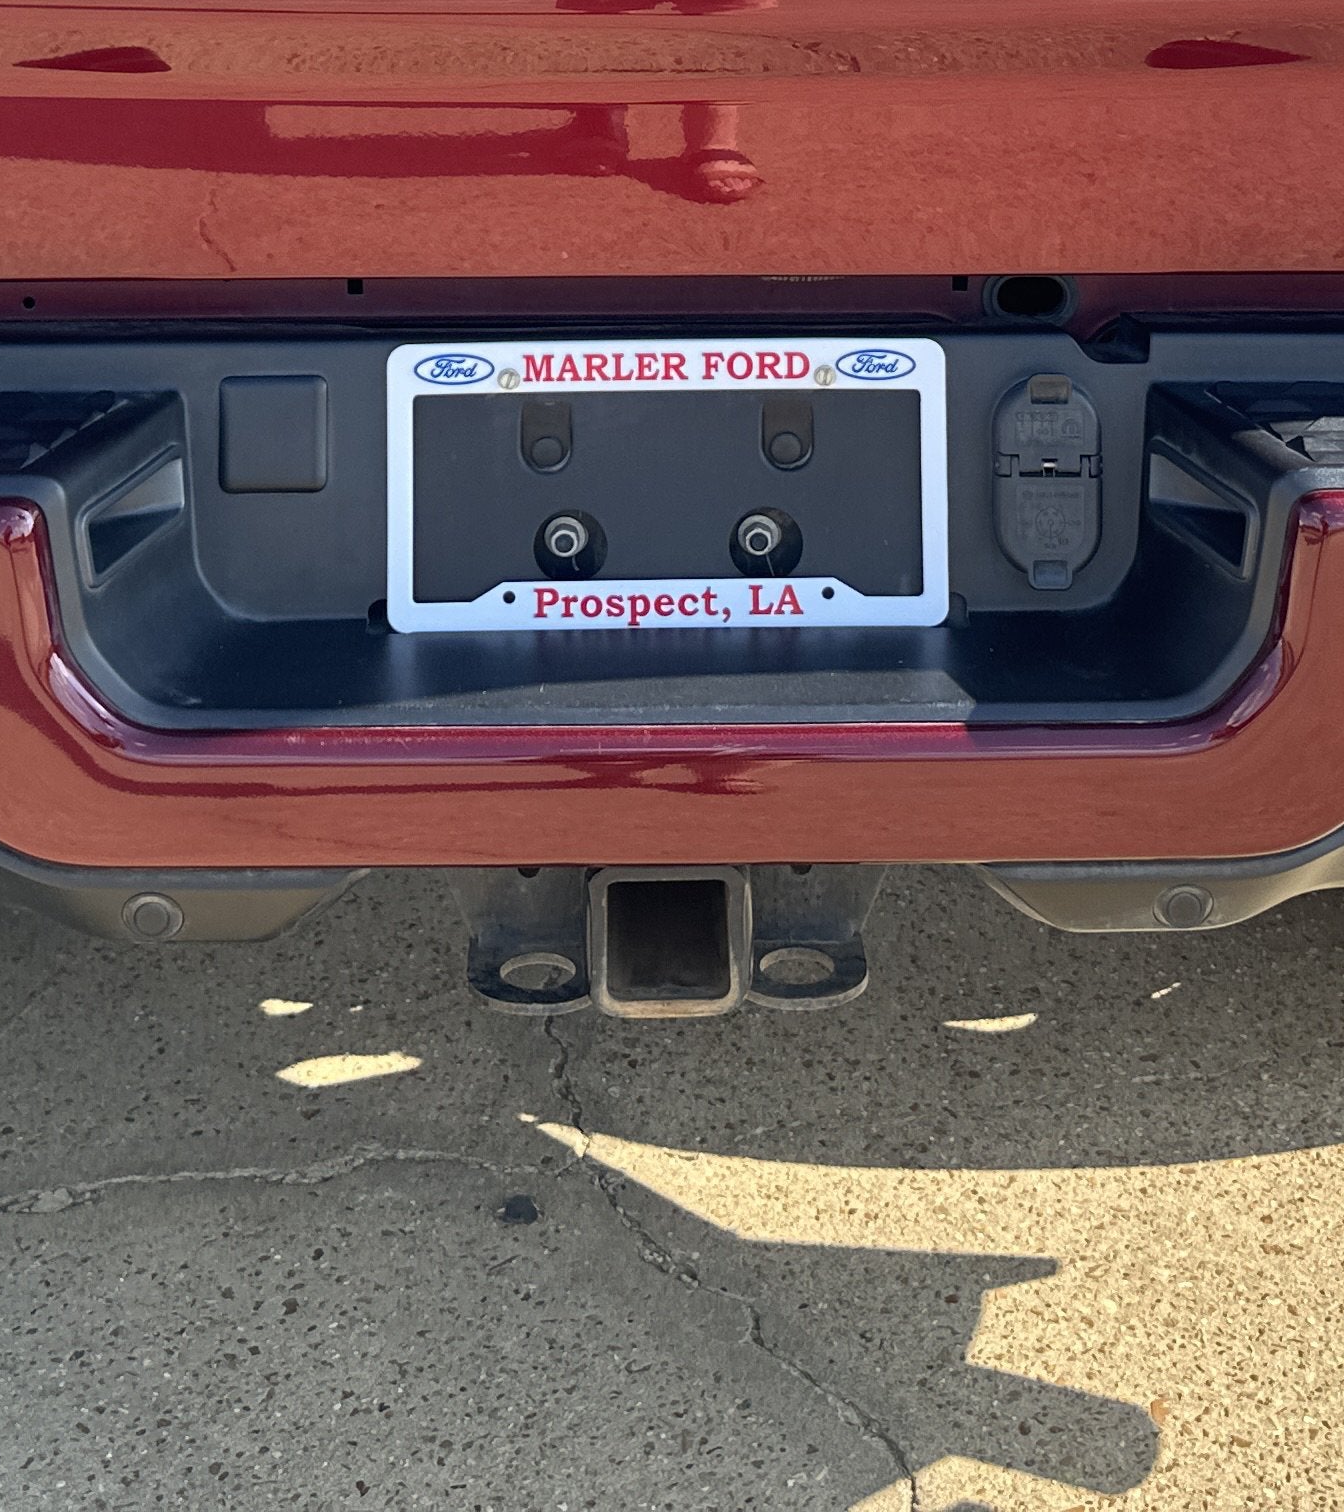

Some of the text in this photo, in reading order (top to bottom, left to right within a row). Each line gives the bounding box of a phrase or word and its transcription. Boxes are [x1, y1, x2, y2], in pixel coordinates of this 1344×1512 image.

[430, 357, 478, 379] Ford
[522, 351, 811, 383] MARLER FORD
[851, 353, 899, 375] Ford
[533, 583, 804, 627] Prospect, LA
